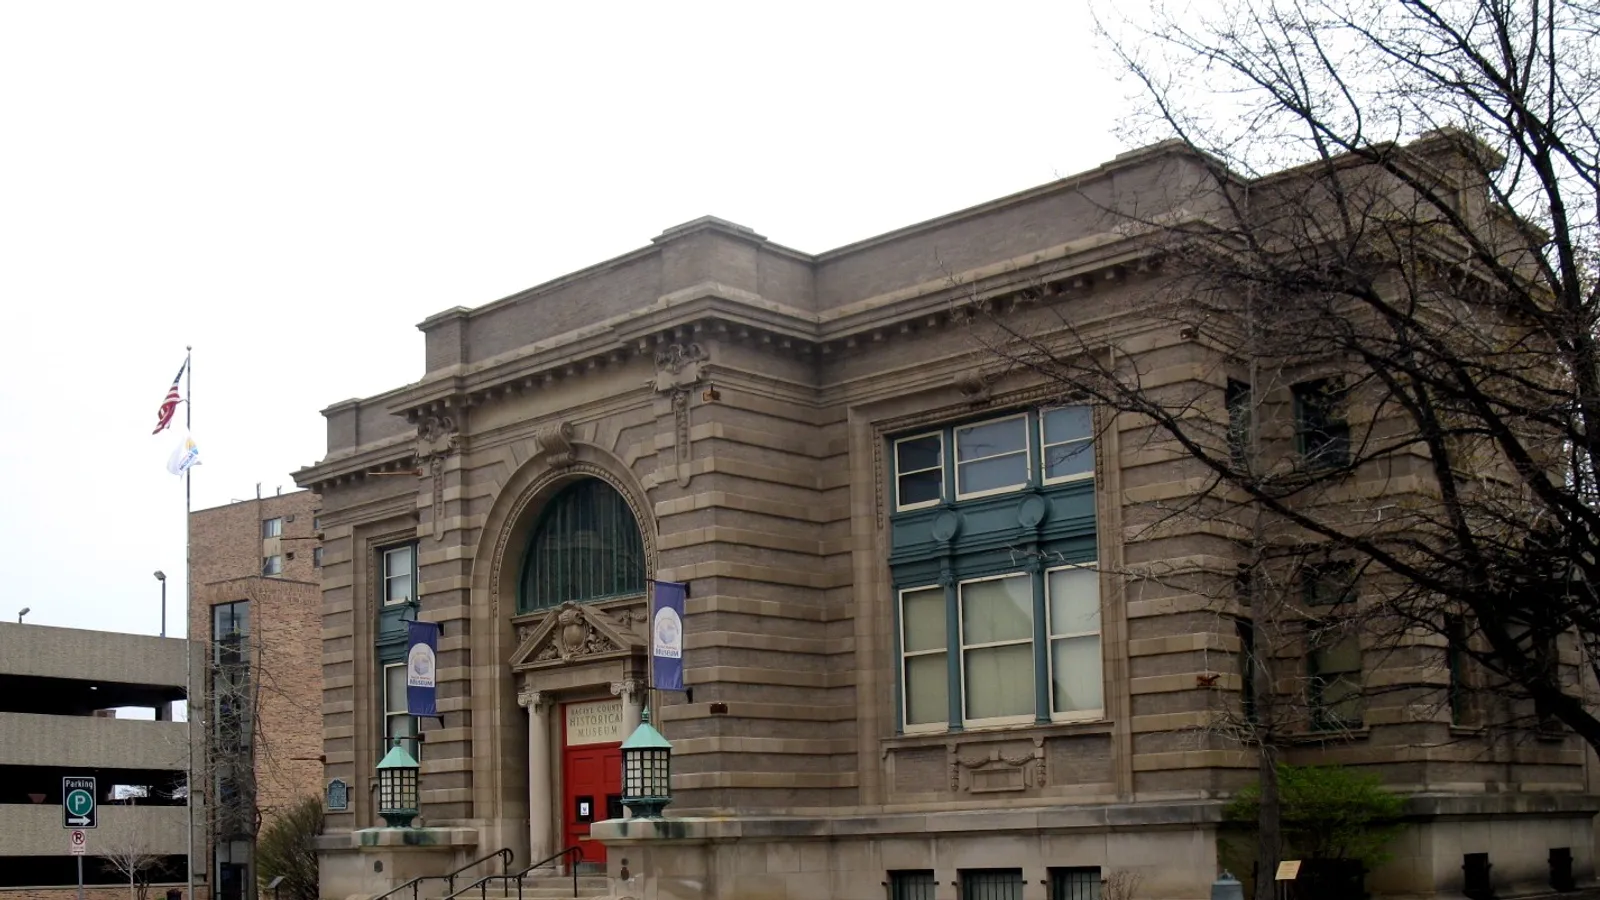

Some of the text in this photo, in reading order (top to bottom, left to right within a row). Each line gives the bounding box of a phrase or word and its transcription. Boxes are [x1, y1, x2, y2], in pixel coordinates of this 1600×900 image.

[597, 703, 623, 713] COUNTY
[578, 726, 618, 737] MUSEUM
[65, 779, 93, 790] Parking
[75, 795, 86, 811] P
